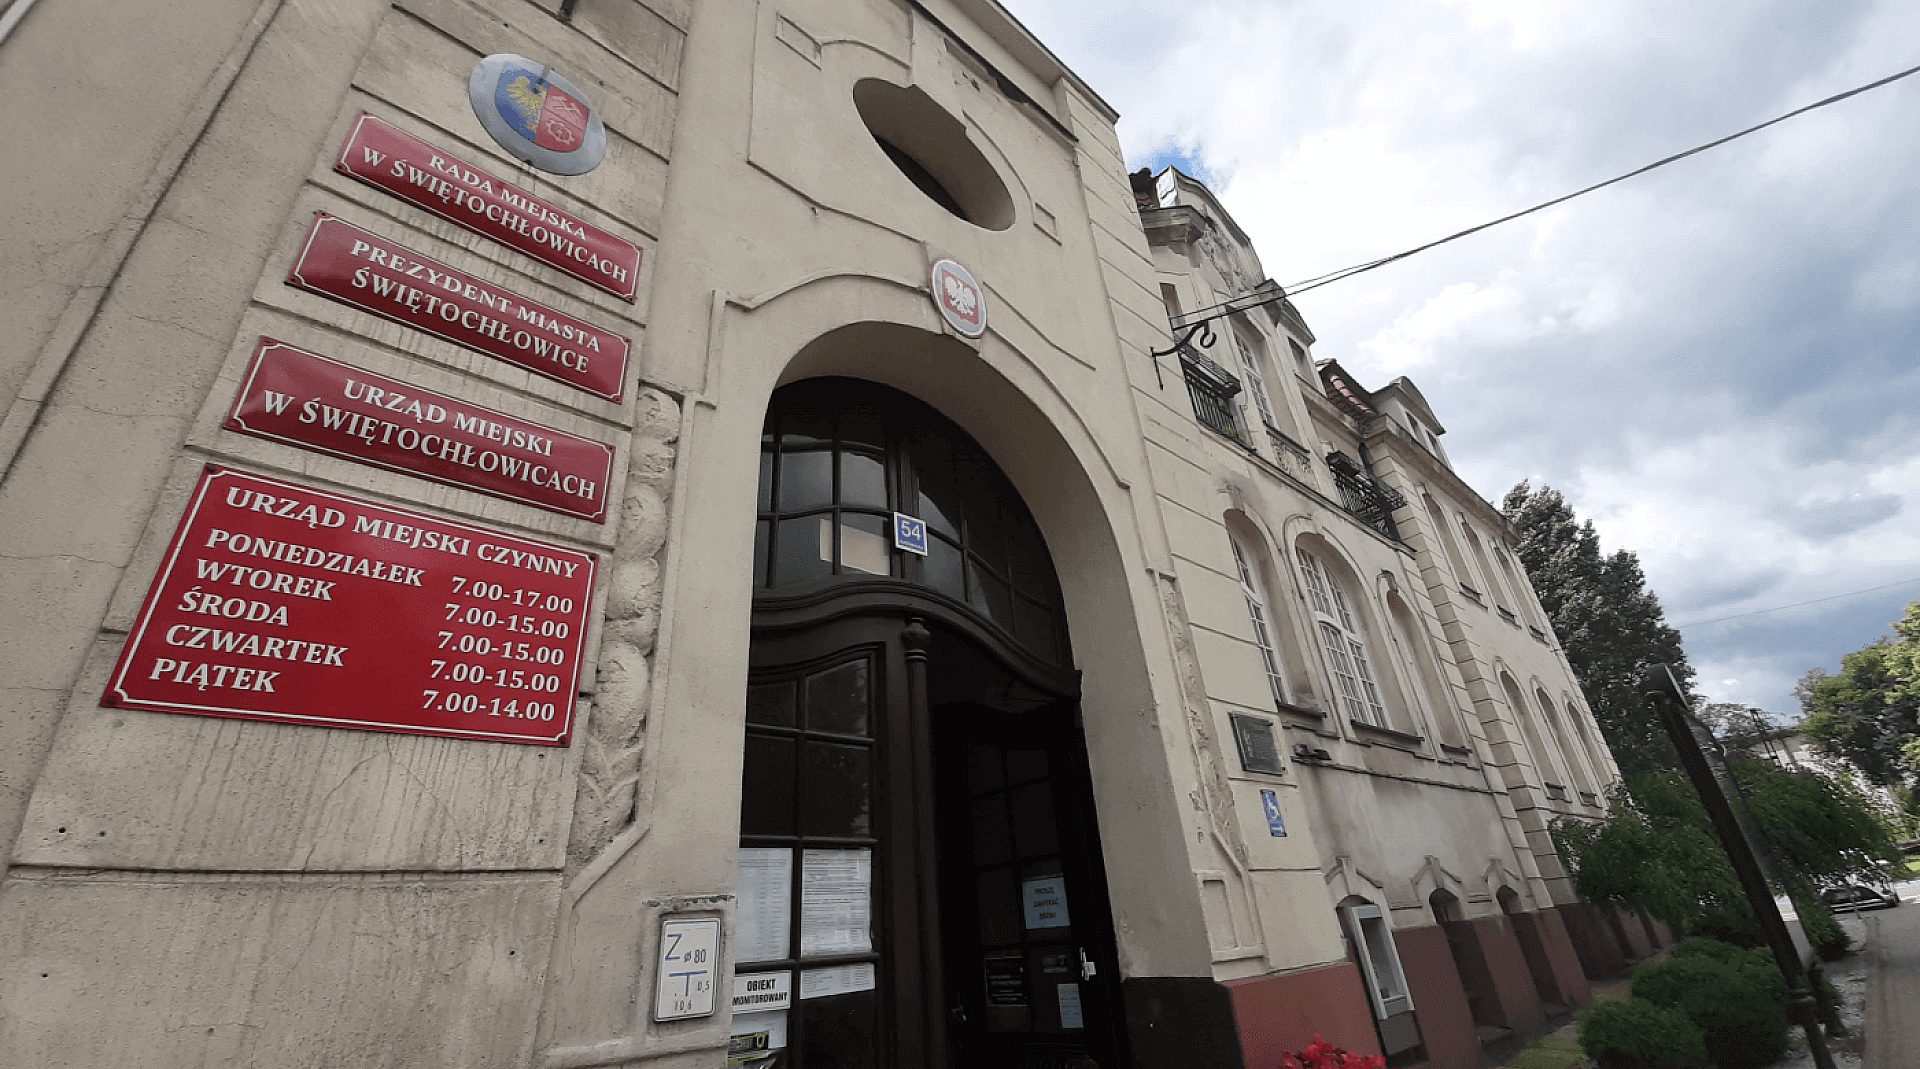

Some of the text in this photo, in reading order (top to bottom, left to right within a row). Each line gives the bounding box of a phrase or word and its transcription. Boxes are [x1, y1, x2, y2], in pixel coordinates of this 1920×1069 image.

[363, 146, 627, 284] W ŚWIĘTOCHŁOWICACH
[429, 156, 587, 241] RADA MIEJSKA
[350, 239, 601, 353] PREZYDENT MIASTA
[351, 267, 589, 374] ŚWIĘTOCHŁOWICE
[262, 389, 597, 501] W ŚWIĘTOCHŁOWICACH
[343, 379, 554, 457] URZĄD MIEJSKI
[225, 486, 579, 579] URZĄD MIEJSKI CZYNNY
[902, 521, 920, 540] 54
[195, 559, 570, 640] WTOREK 7.00-15.00
[204, 529, 575, 614] PONIEDZIAŁEK 7.00-17.00
[164, 623, 561, 693] CZWARTEK 7.00-15.00
[178, 586, 565, 666] ŚRODA 7.00-15.00
[148, 658, 556, 722] PIĄTEK 7.00-14.00
[665, 933, 682, 961] Z
[747, 979, 776, 992] OBIEKT
[732, 992, 788, 1006] MONITOROWANY
